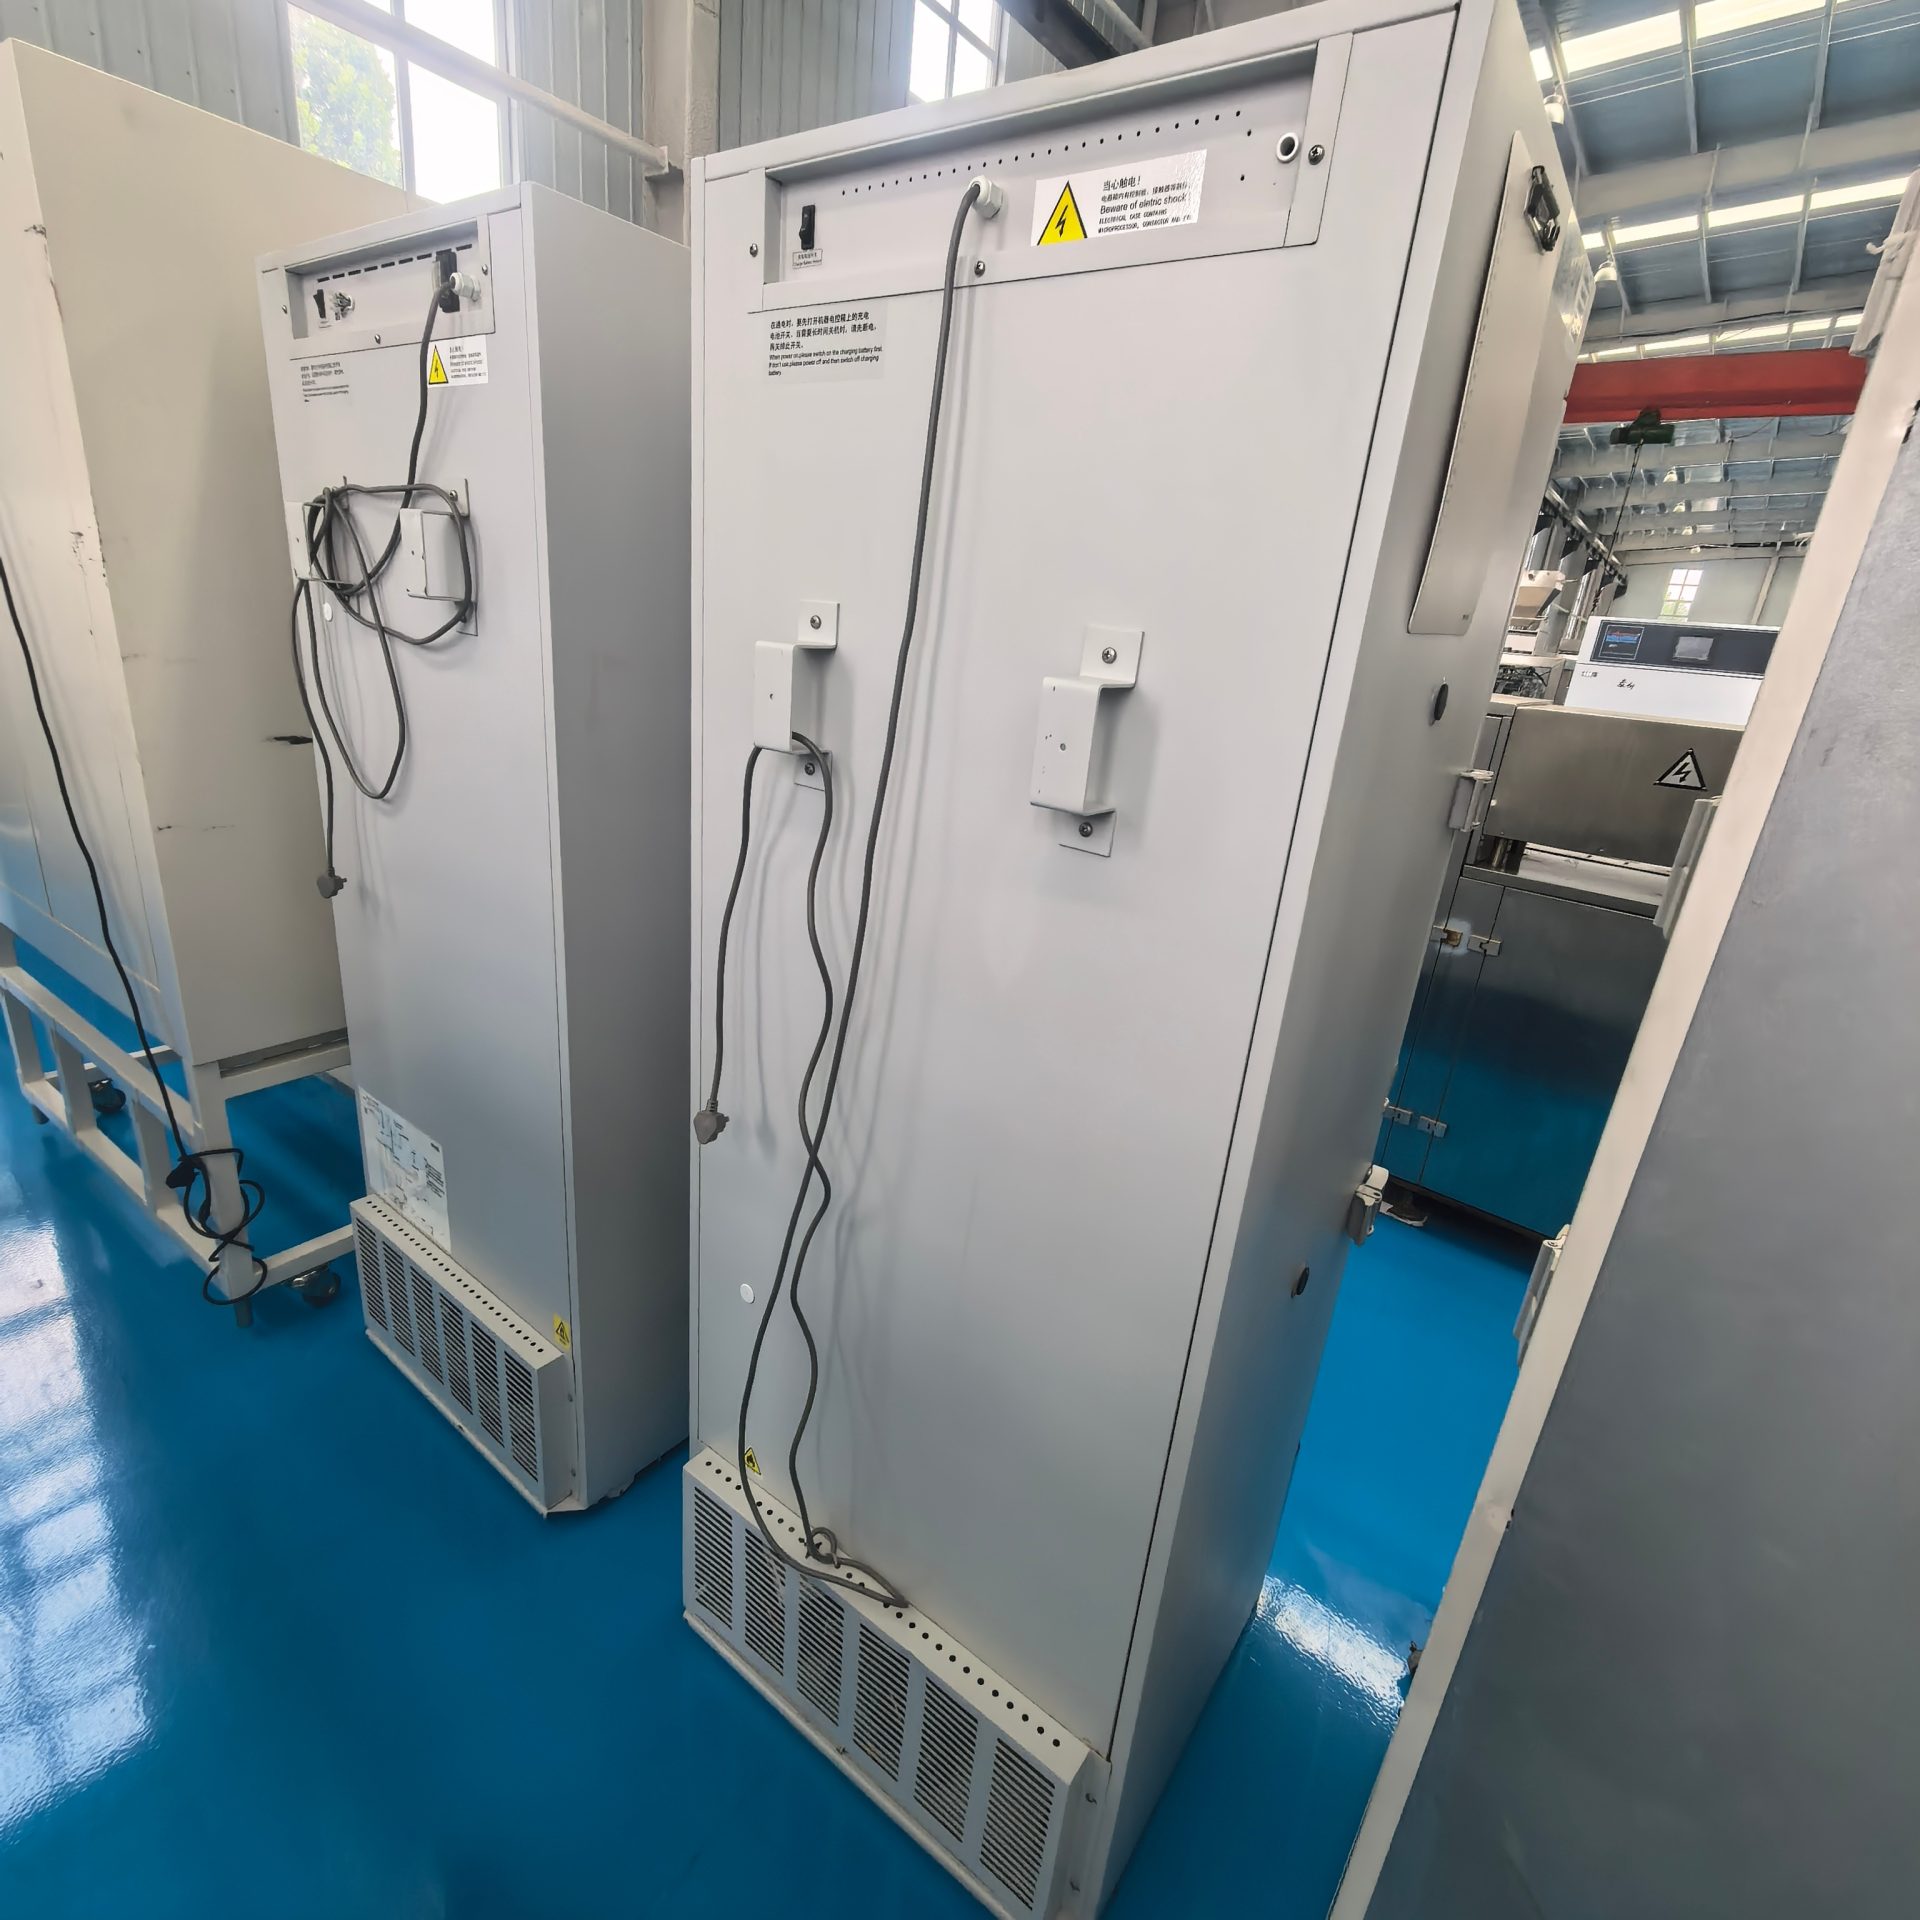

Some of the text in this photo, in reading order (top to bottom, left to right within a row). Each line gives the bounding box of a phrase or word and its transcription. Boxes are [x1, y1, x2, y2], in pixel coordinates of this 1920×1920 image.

[1100, 203, 1128, 214] Beware
[1130, 200, 1138, 210] of
[1143, 209, 1167, 217] CONTAINS
